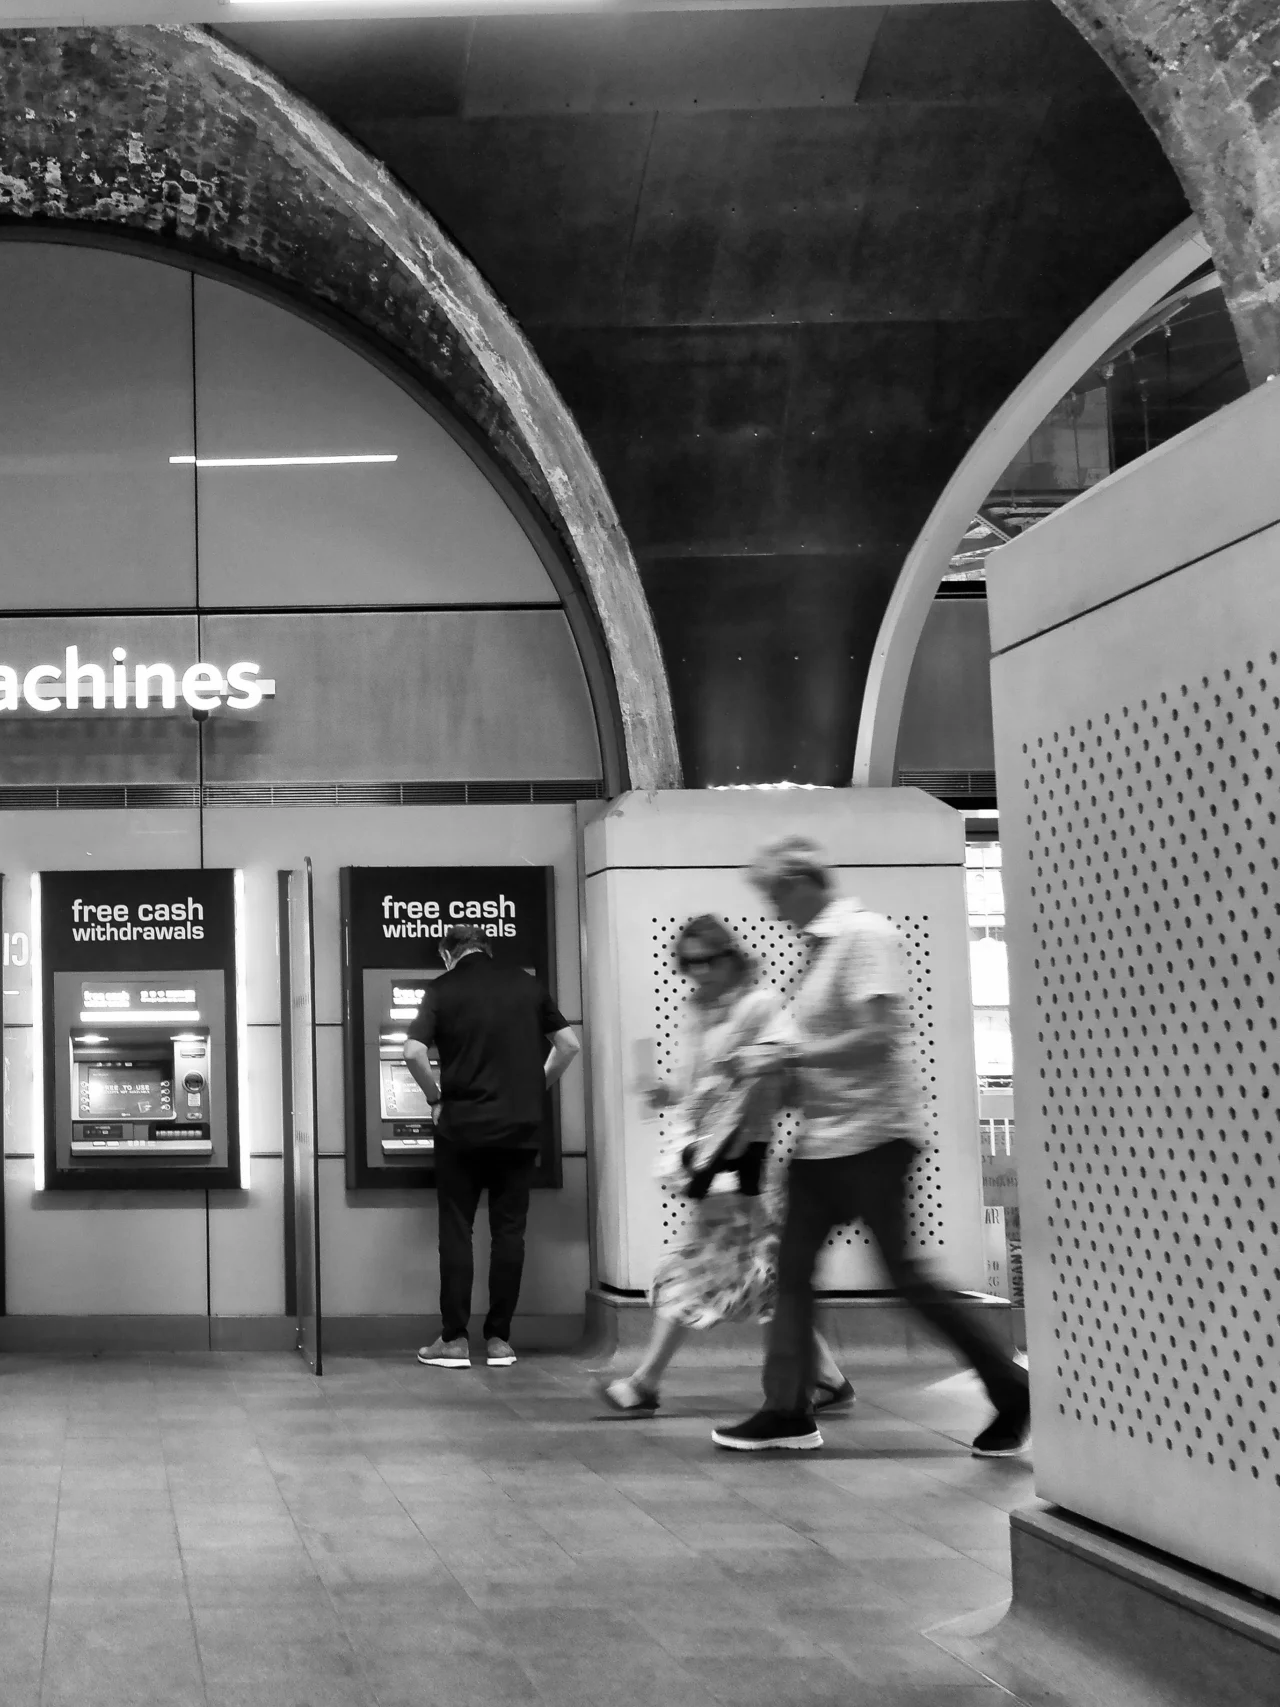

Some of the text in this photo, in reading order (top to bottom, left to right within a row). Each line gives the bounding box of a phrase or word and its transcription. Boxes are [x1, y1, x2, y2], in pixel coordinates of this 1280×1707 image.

[72, 897, 204, 923] free cash
[381, 894, 516, 919] free cash
[72, 921, 204, 941] withdrawals
[382, 919, 516, 938] withdrals
